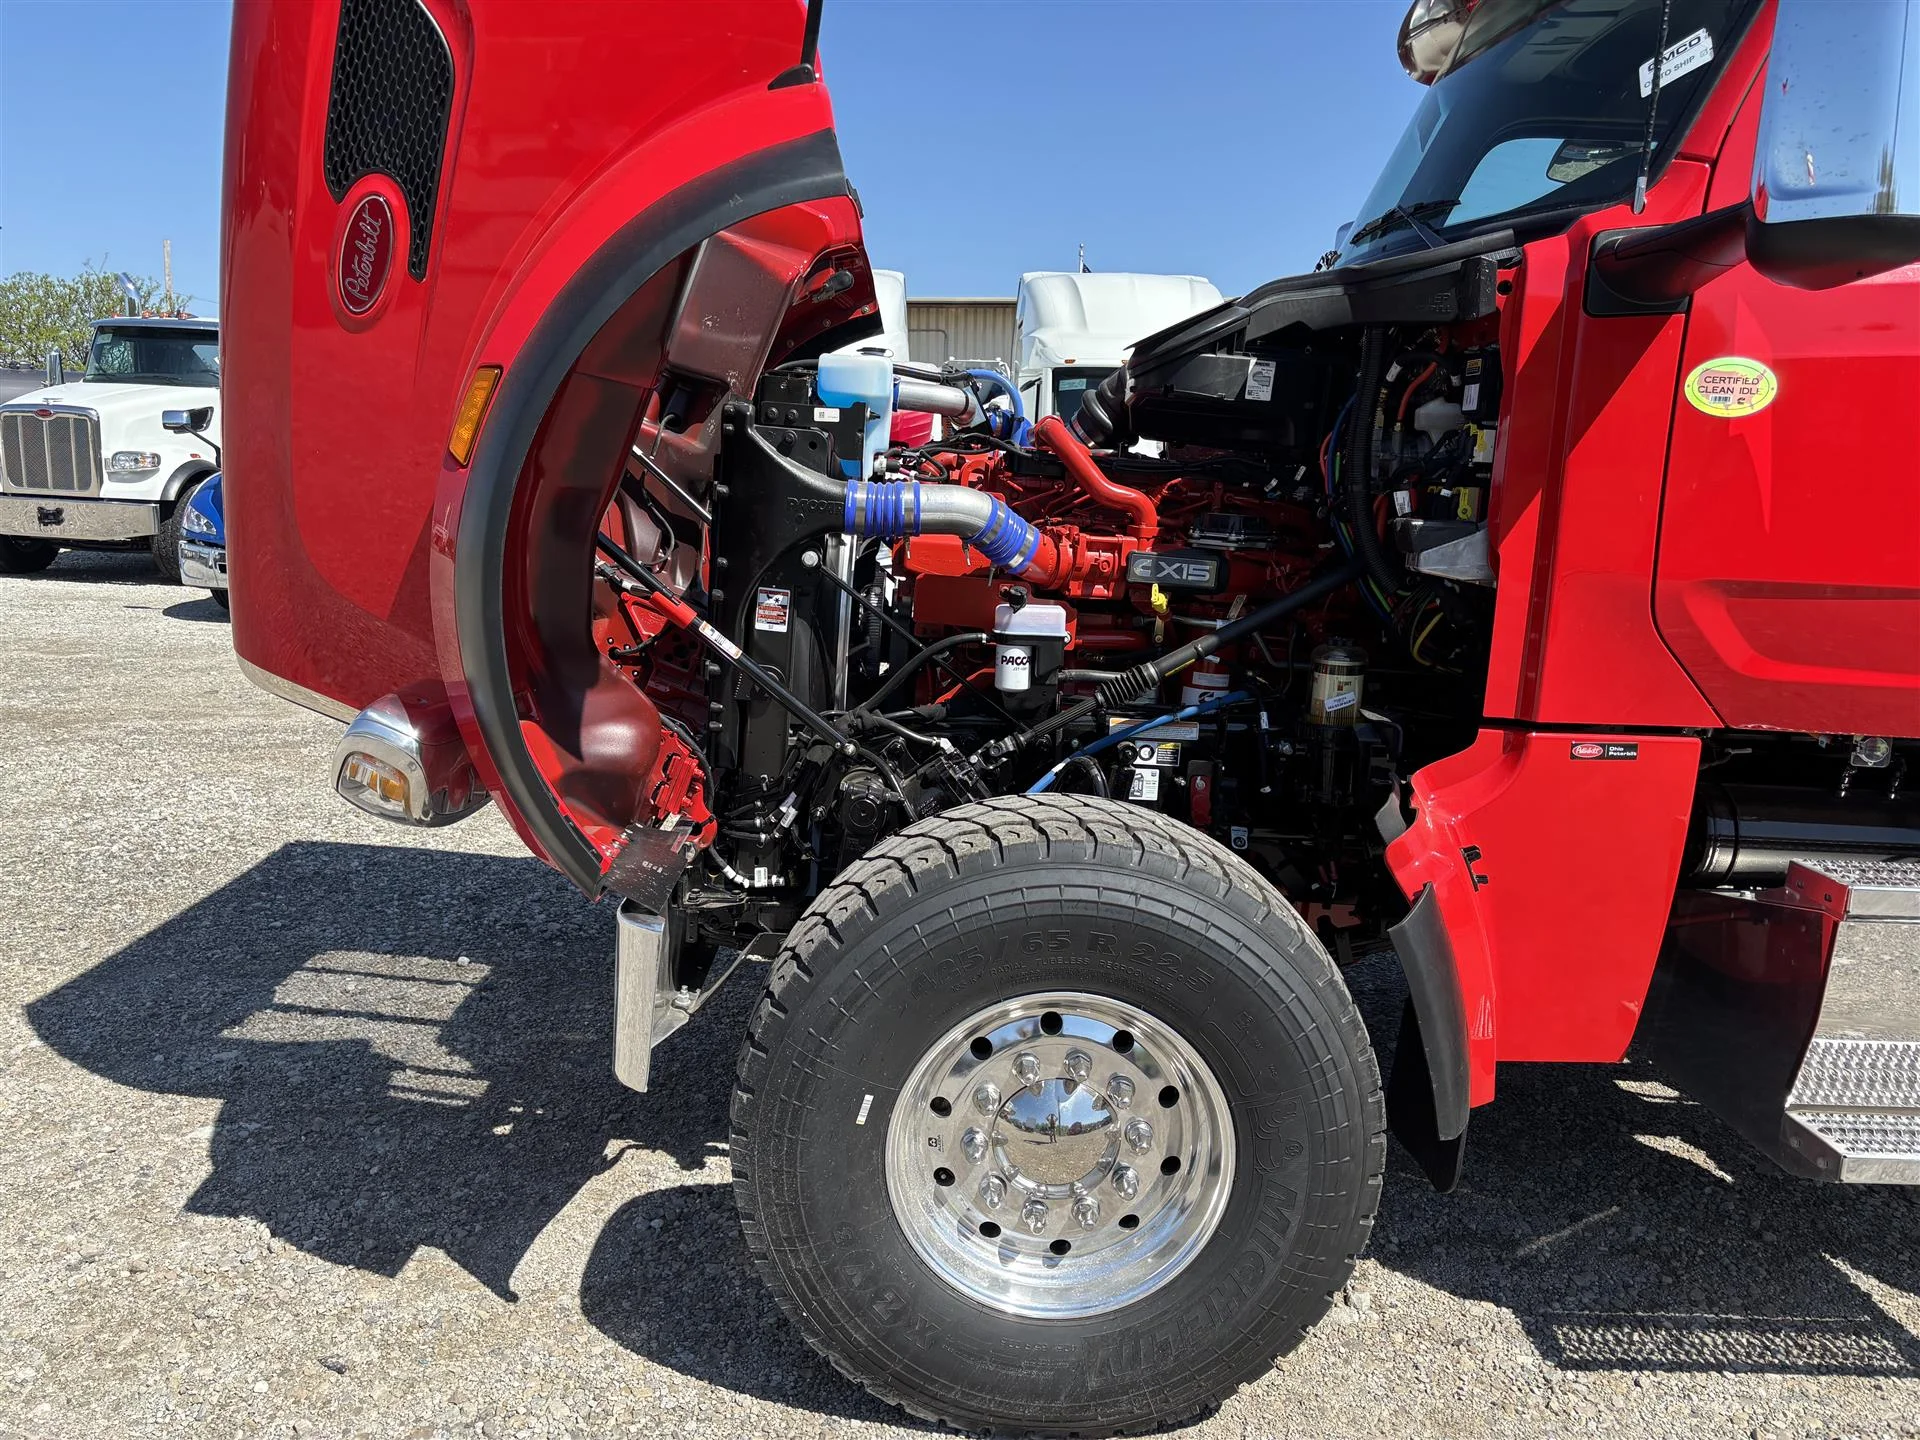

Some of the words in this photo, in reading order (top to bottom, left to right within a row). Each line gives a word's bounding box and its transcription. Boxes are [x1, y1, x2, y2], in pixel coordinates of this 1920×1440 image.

[1673, 55, 1695, 71] SHIP
[344, 203, 382, 301] Peterbilt
[1704, 376, 1760, 385] CERTIFIED
[1697, 385, 1735, 395] CLEAN
